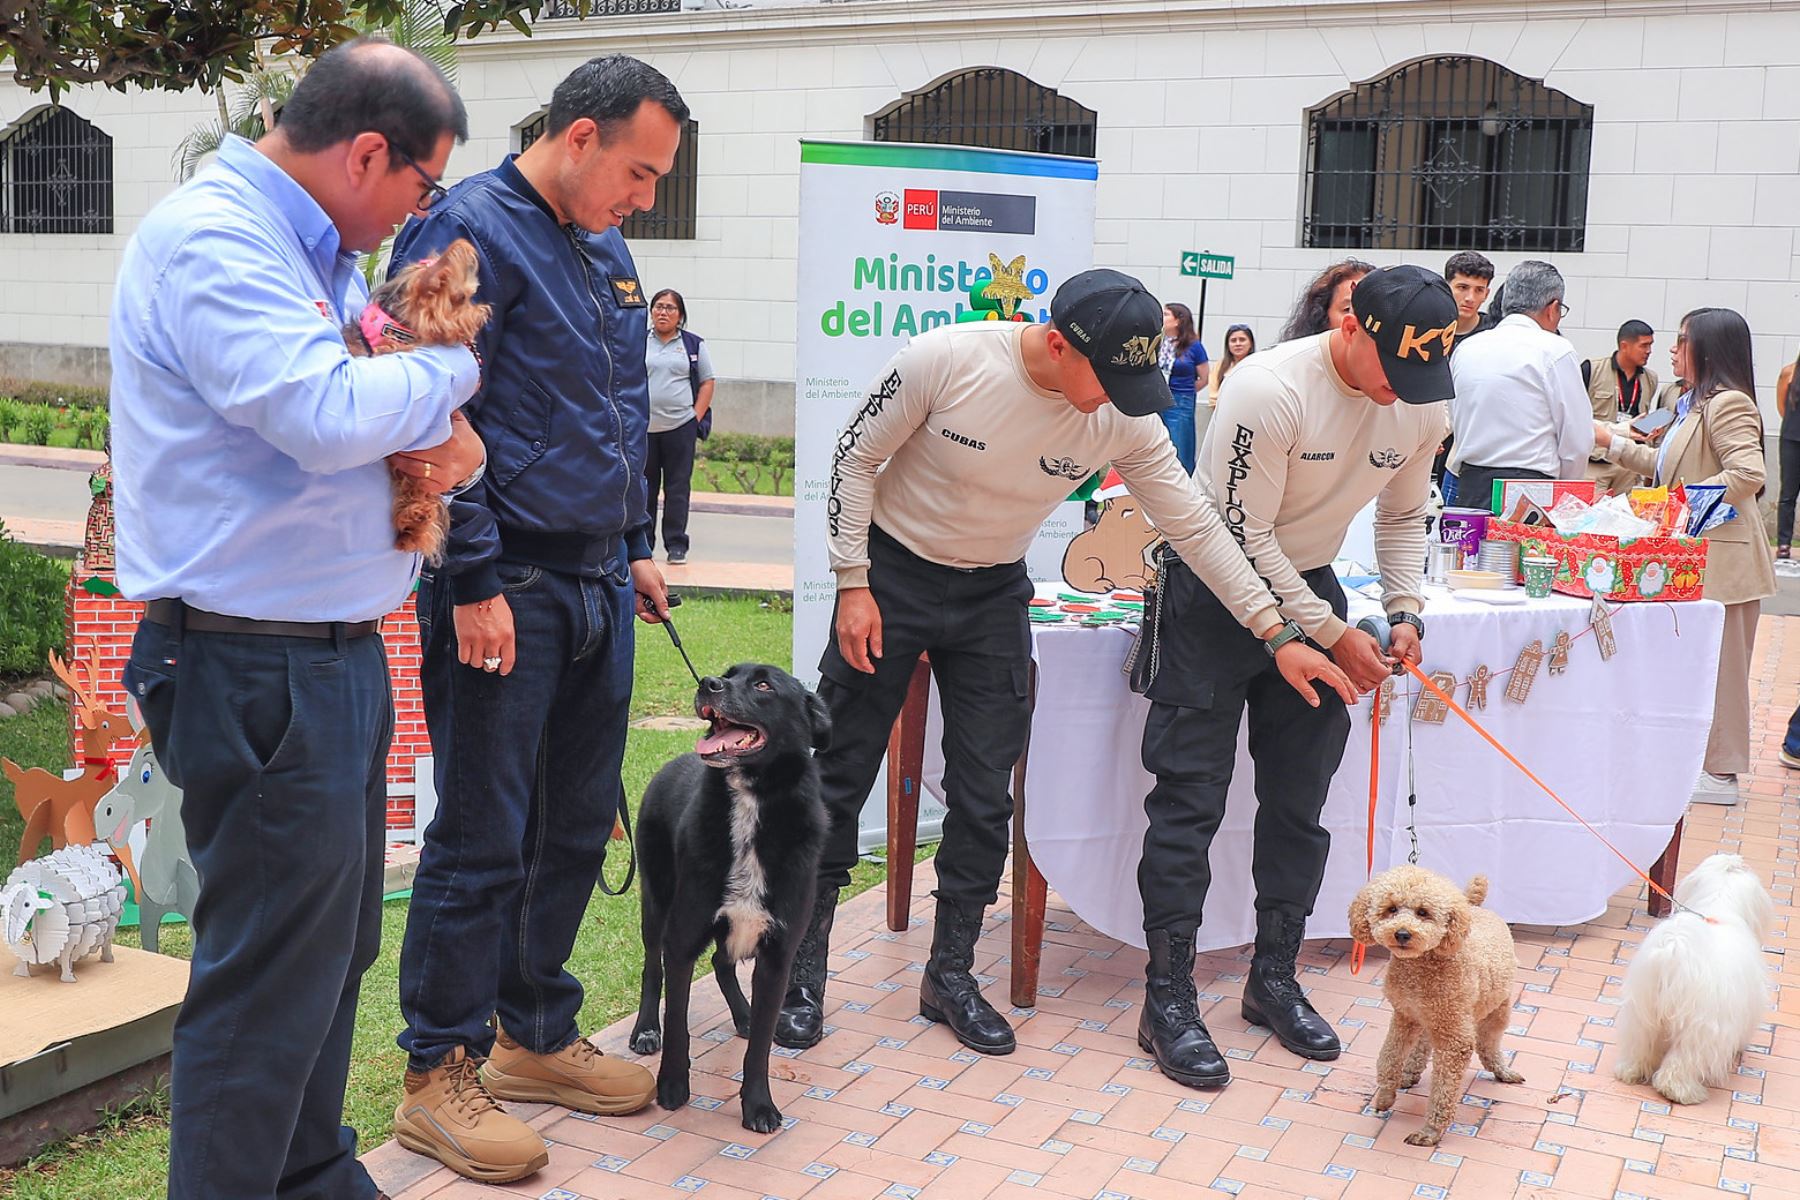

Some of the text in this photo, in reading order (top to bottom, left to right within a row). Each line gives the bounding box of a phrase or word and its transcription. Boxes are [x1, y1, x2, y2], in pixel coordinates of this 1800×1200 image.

[907, 202, 934, 216] PERÚ
[942, 205, 981, 217] Ministerio
[942, 216, 993, 227] del Ambiente
[1200, 258, 1232, 275] SALIDA
[854, 252, 1048, 295] Ministeo
[821, 301, 882, 337] del
[1070, 322, 1091, 343] CUBAS
[1397, 320, 1458, 361] K9
[805, 377, 849, 387] Ministerio
[805, 389, 863, 399] del Ambiente
[941, 428, 987, 451] CUBAS
[827, 368, 902, 538] EXPLOSIVOS
[1300, 452, 1336, 461] ALARCON
[804, 492, 818, 500] del
[1042, 519, 1067, 528] sterio
[803, 581, 836, 590] Ministe
[803, 593, 817, 602] del
